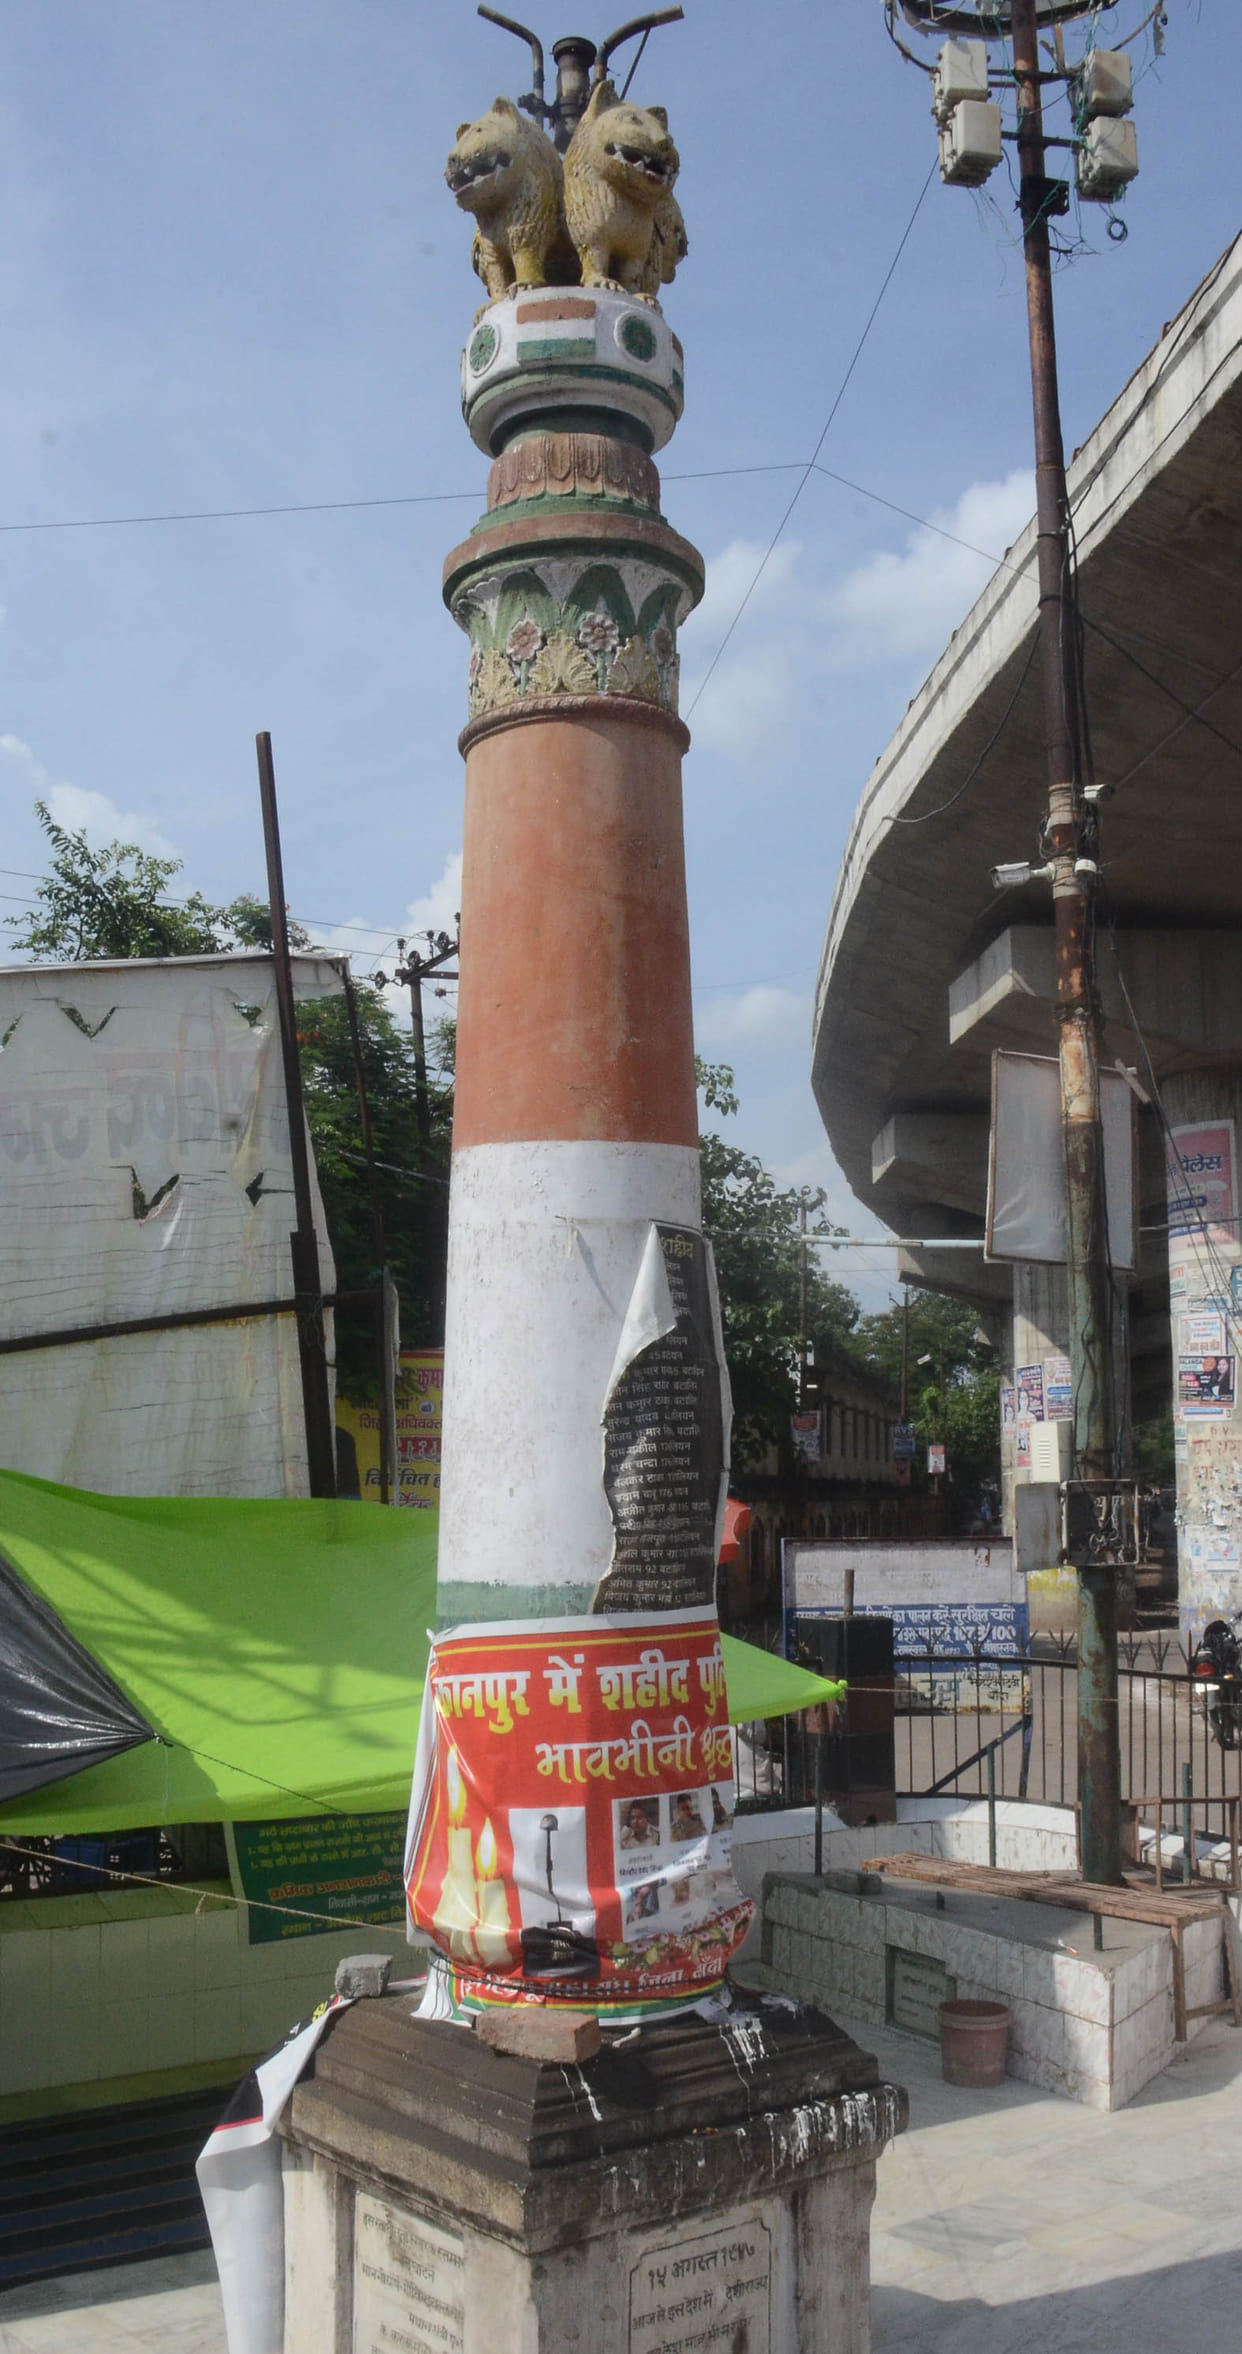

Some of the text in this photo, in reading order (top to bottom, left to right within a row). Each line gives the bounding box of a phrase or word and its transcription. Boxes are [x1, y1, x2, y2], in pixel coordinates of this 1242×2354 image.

[432, 1671, 530, 1734] कानपुर
[543, 1653, 586, 1713] में
[596, 1648, 690, 1711] शहीद
[535, 1715, 697, 1784] भावभीनी
[671, 2250, 717, 2279] अगस्त
